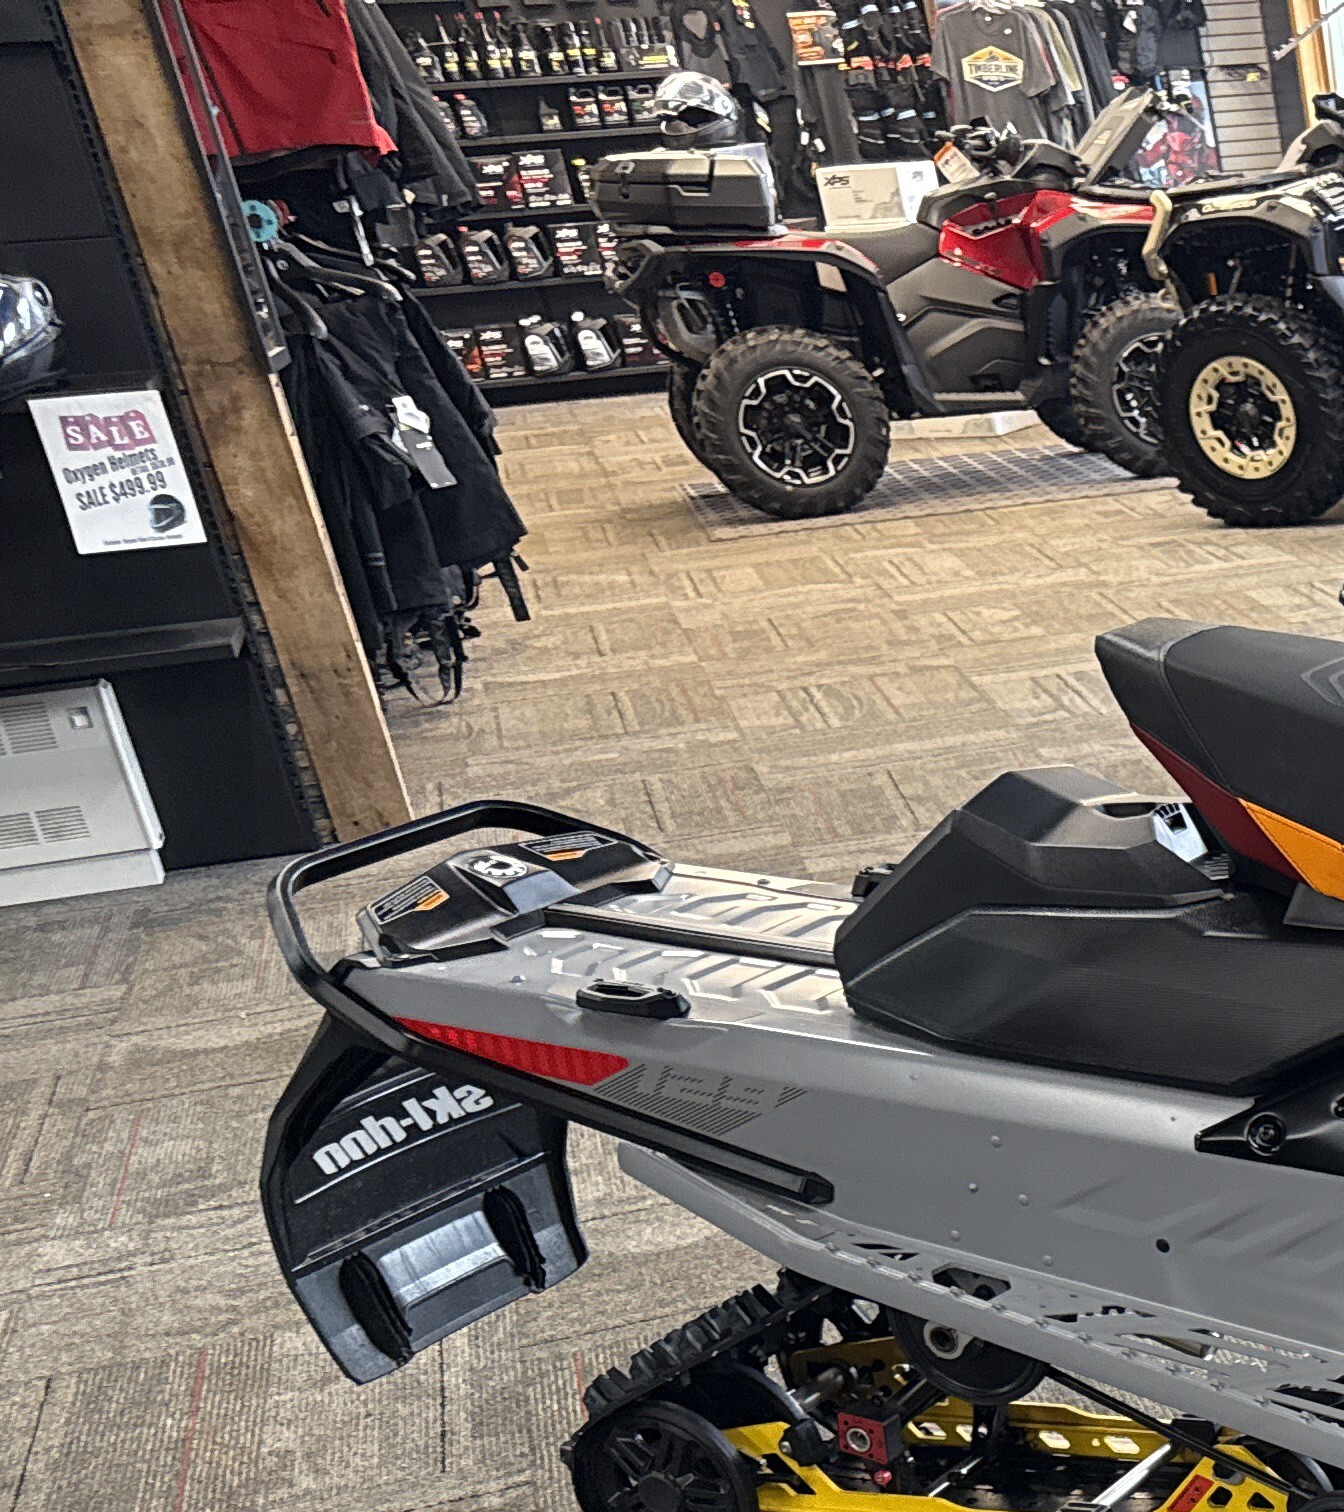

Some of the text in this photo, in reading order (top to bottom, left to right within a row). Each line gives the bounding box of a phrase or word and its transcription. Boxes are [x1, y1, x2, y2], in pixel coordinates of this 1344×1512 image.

[823, 174, 850, 187] XPS
[66, 419, 150, 445] SALE
[62, 461, 109, 485] Oxygen
[107, 447, 159, 473] Helmets
[75, 470, 168, 511] SALE $499.99
